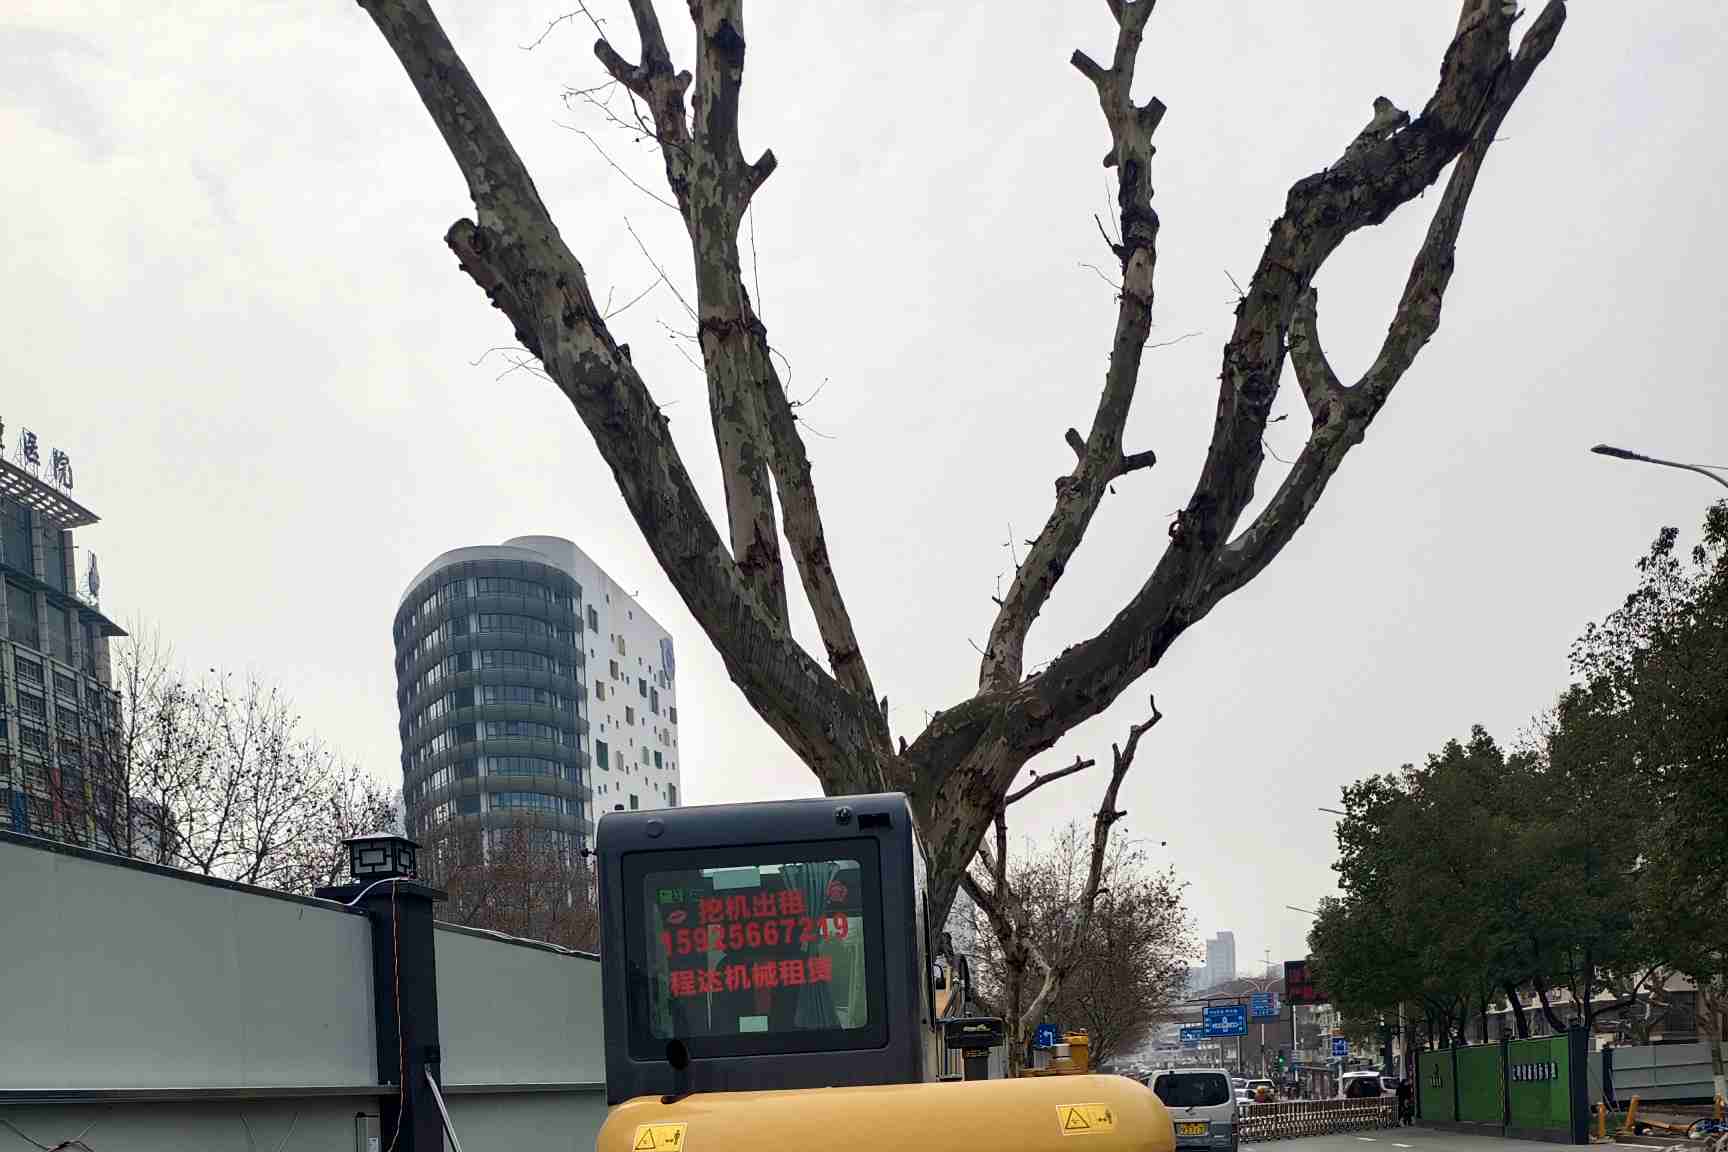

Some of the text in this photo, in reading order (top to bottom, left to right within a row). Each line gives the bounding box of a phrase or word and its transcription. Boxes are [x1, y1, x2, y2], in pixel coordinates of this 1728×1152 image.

[701, 888, 806, 923] 挖机出租
[670, 955, 832, 996] 程达机械租赁
